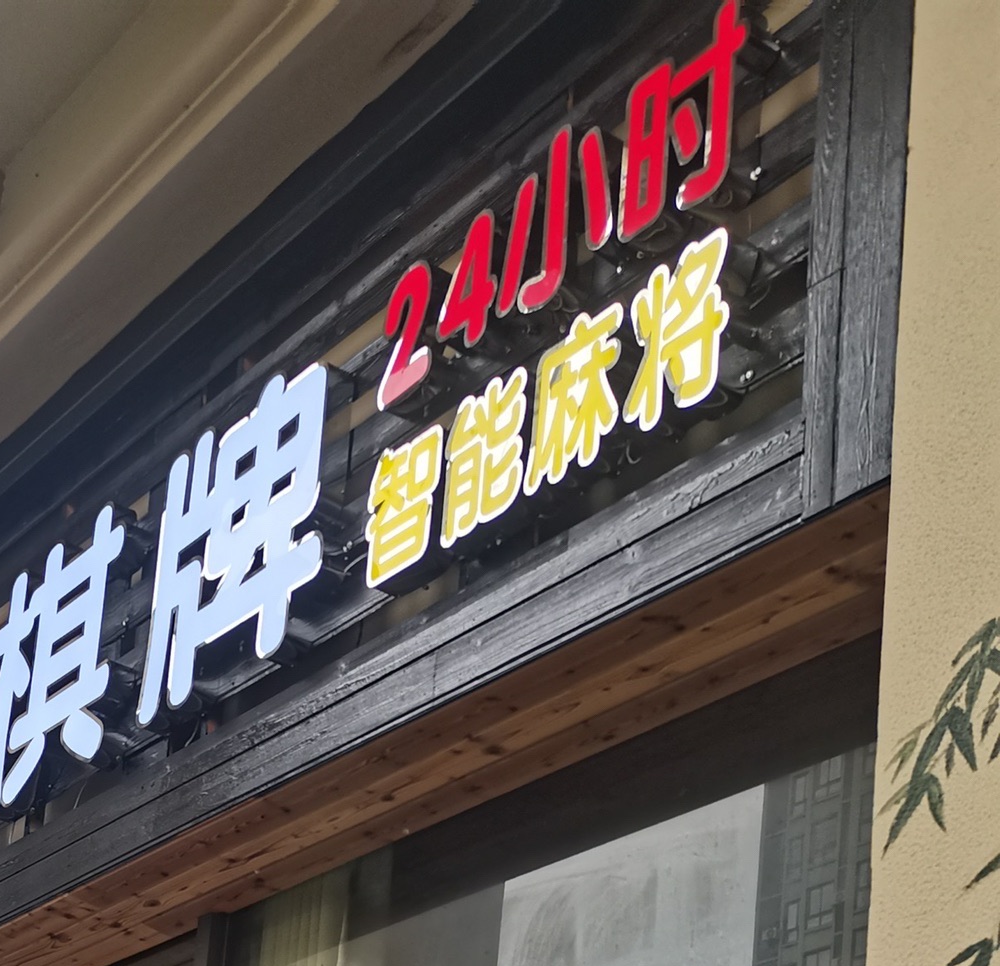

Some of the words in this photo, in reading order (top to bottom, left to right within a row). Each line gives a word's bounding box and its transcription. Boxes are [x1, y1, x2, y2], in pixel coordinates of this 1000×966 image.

[378, 0, 748, 411] 24小时
[366, 227, 731, 590] 智能麻将
